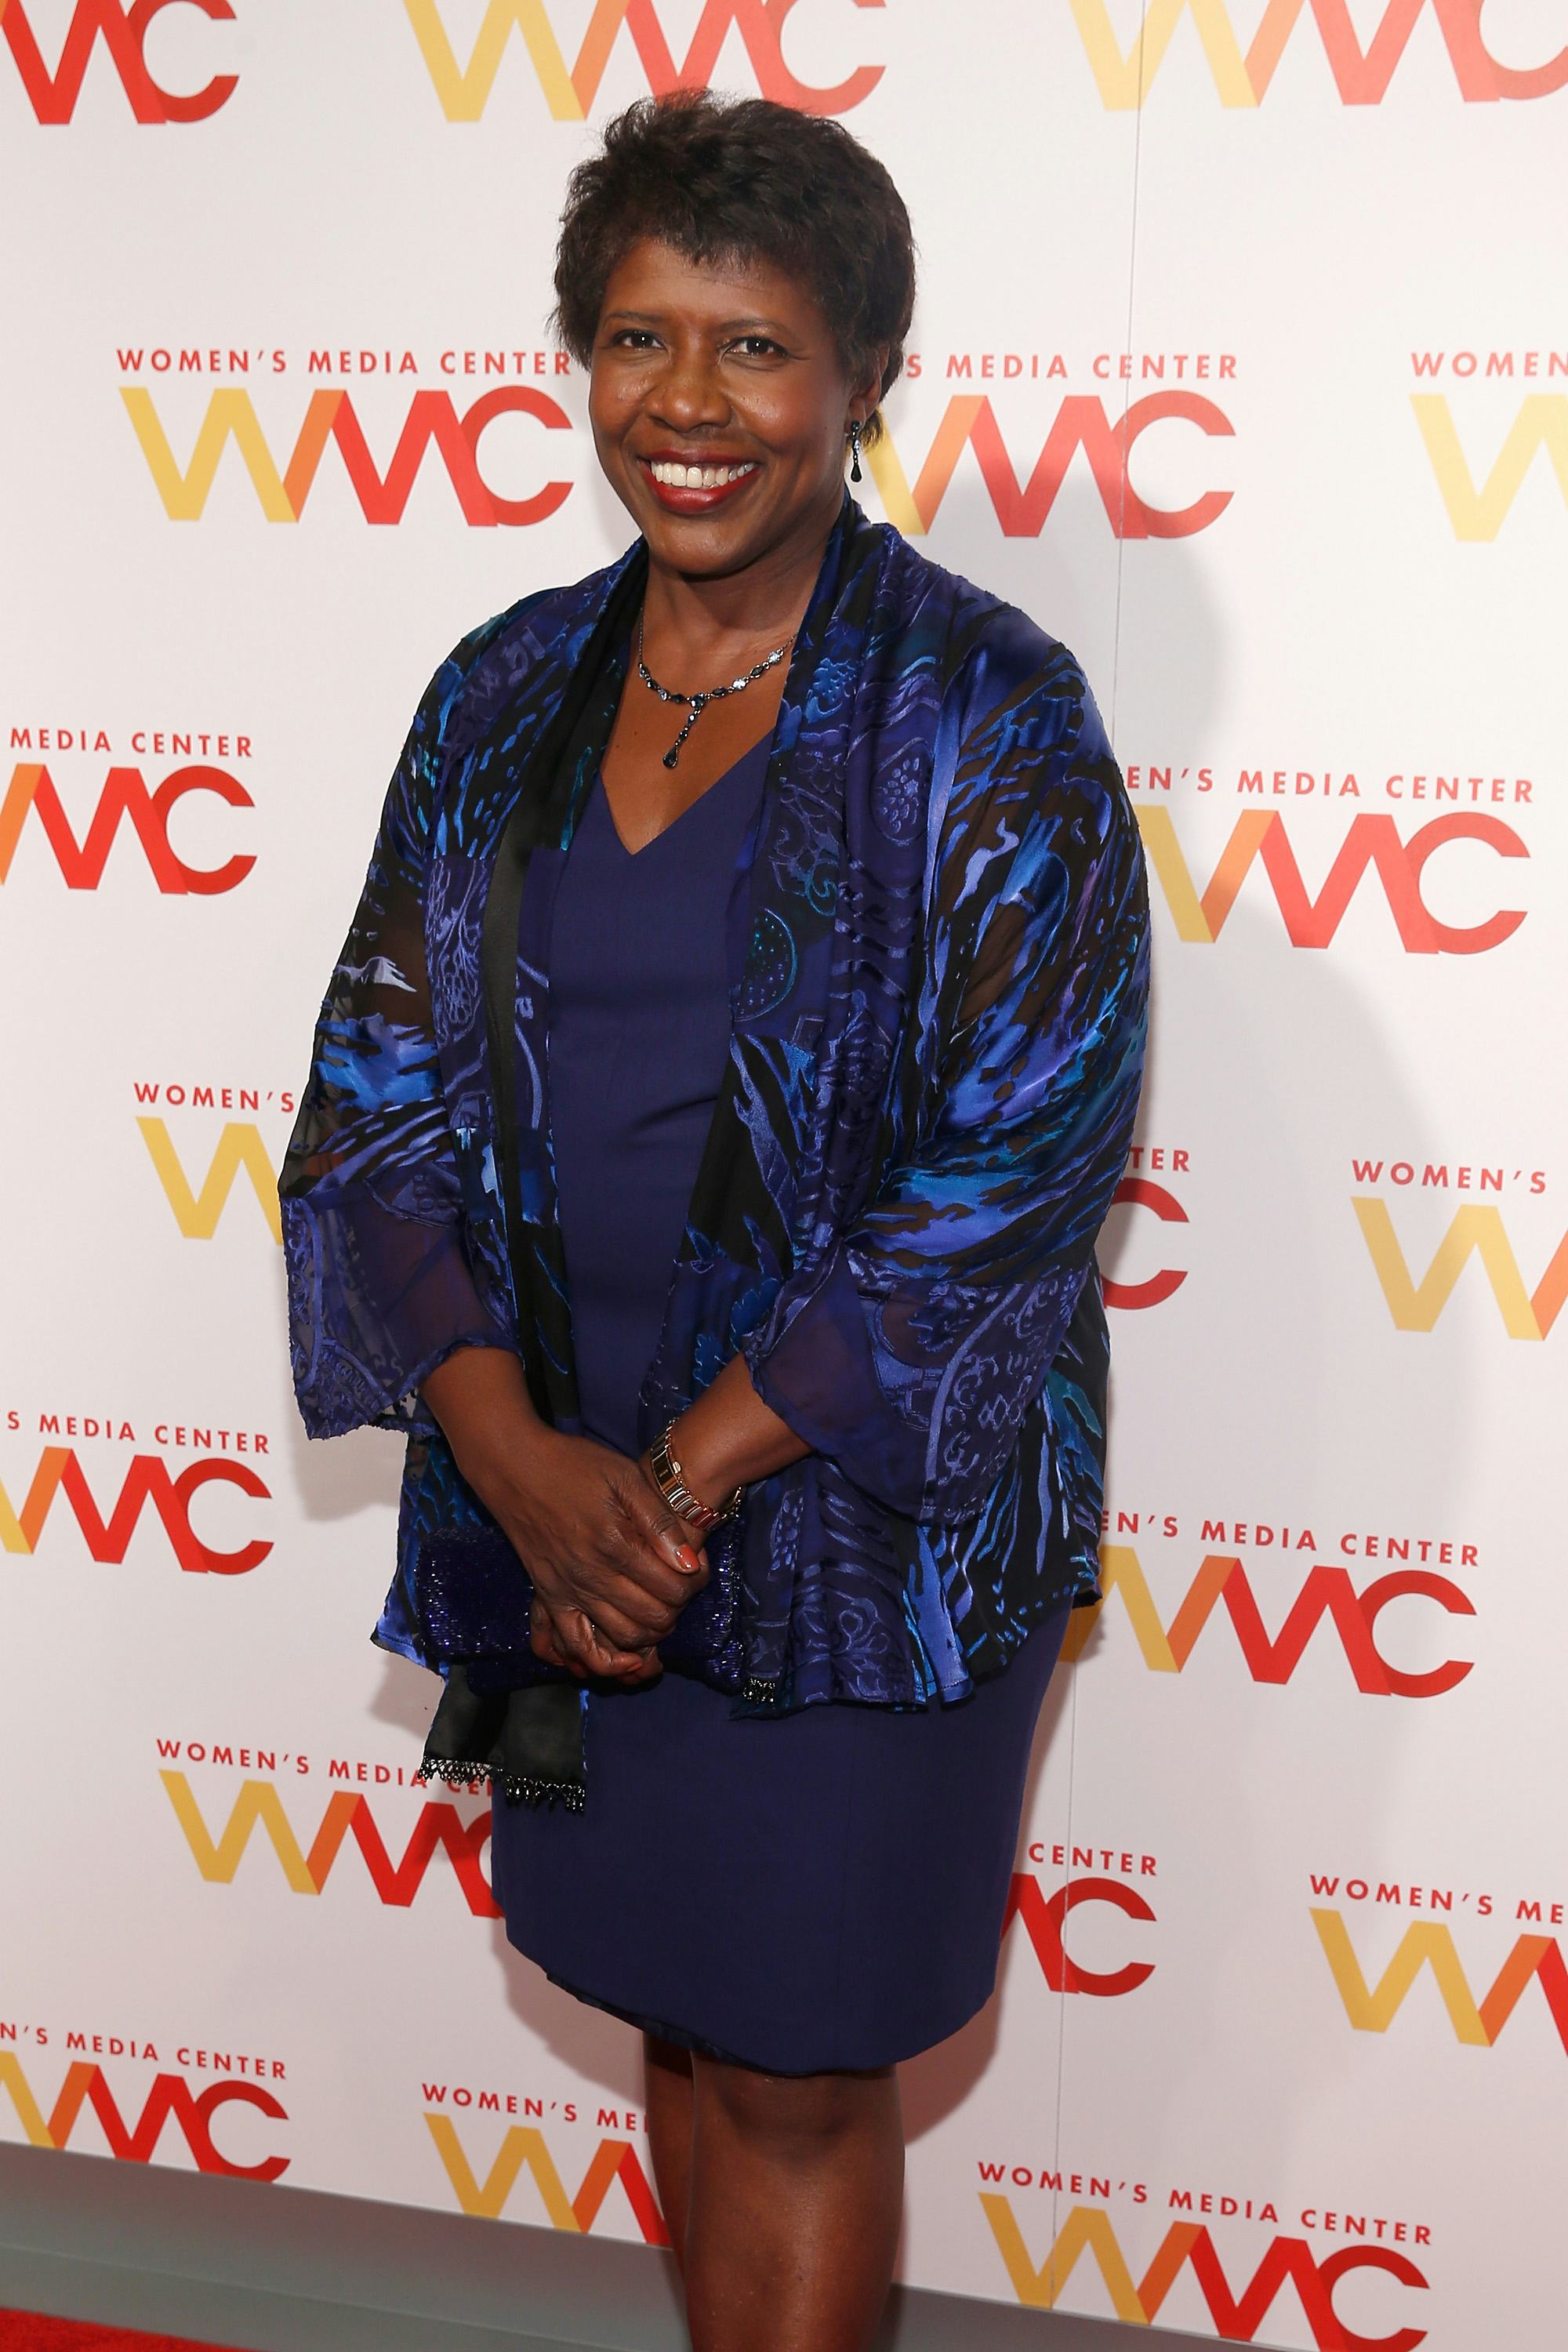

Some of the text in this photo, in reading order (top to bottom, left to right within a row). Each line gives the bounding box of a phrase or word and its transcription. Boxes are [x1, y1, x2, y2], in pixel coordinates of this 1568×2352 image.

[0, 0, 240, 125] MC
[116, 348, 572, 376] WOMEN'S MEDIA CENTER
[946, 354, 1068, 379] MEDIA
[1092, 354, 1238, 379] CENTER
[1410, 350, 1568, 378] WOMEN
[118, 384, 575, 528] WMC
[10, 727, 253, 758] MEDIA CENTER
[1126, 765, 1534, 804] EN'S MEDIA CENTER
[0, 762, 258, 895] MC
[132, 1081, 296, 1114] WOMEN'S
[1129, 1145, 1191, 1172] TER
[1352, 1159, 1548, 1194] WOMEN'S
[38, 1413, 136, 1442] MEDIA
[153, 1424, 269, 1454] CENTER
[1200, 1519, 1318, 1552] MEDIA
[1339, 1532, 1479, 1567] CENTER
[155, 1738, 310, 1776] WOMEN'S
[328, 1758, 428, 1790] MEDIA
[1027, 1842, 1158, 1877] CENTER
[1308, 1873, 1494, 1918] WOMEN'S
[66, 2031, 160, 2062] MEDIA
[175, 2046, 287, 2081] CENTER
[421, 2082, 579, 2124] WOMEN'S
[977, 2160, 1432, 2247] WOMEN'S MEDIA CENTER
[977, 2191, 1432, 2352] WMC
